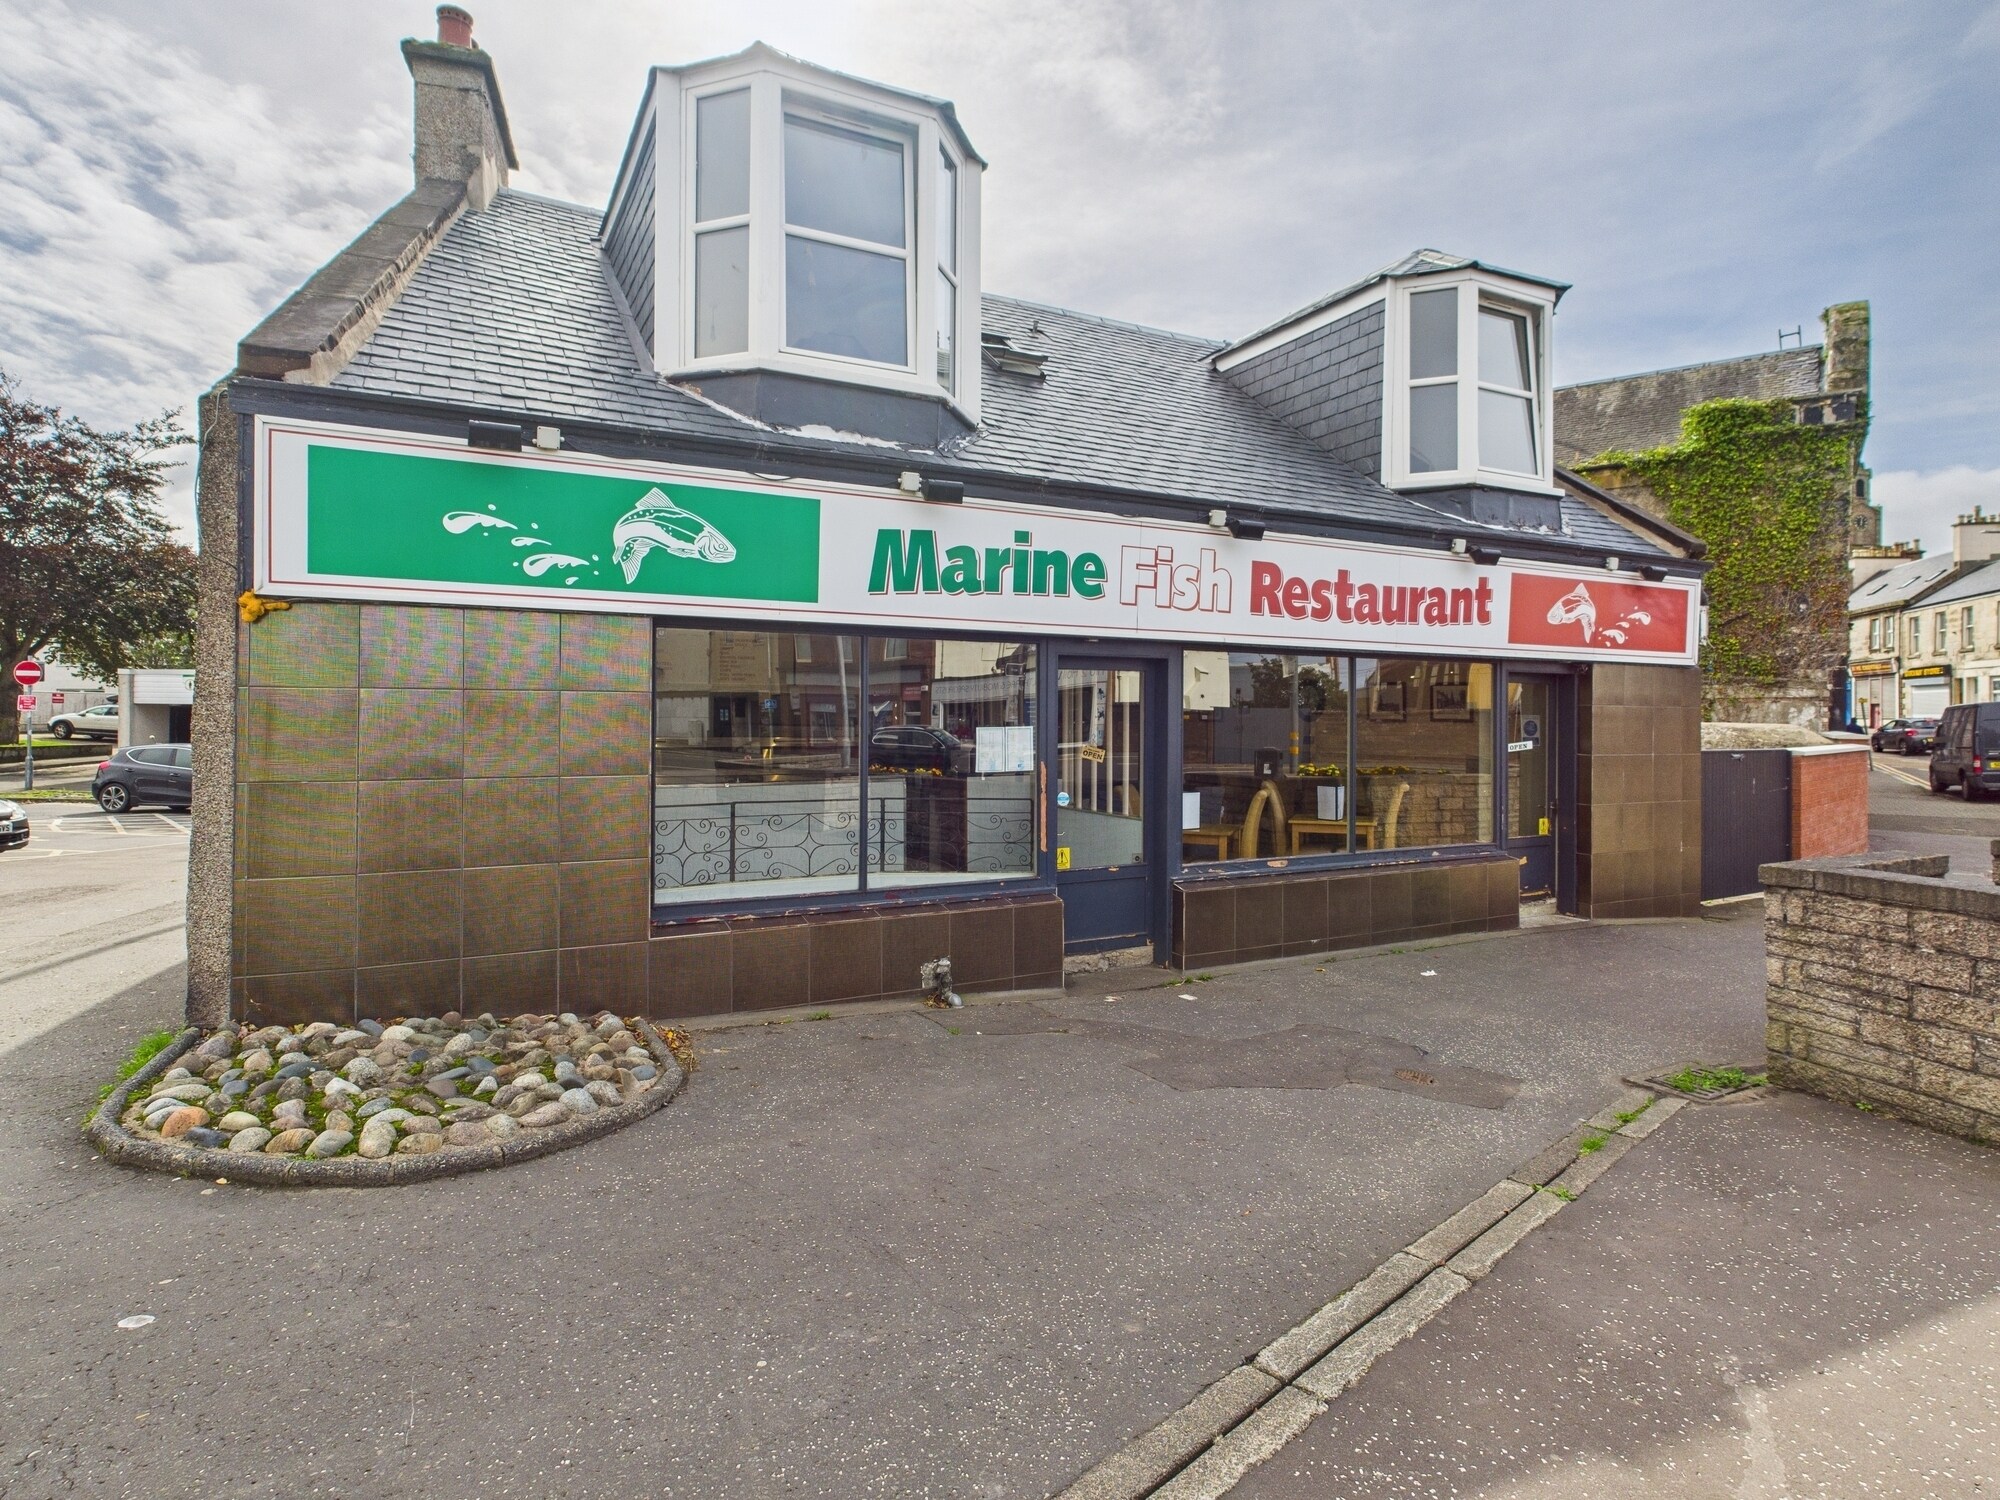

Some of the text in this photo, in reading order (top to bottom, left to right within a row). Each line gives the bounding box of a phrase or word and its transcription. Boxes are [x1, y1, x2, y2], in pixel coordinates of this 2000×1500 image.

[867, 528, 1494, 626] Marine Fish Restaurant
[1082, 750, 1103, 760] OPEN
